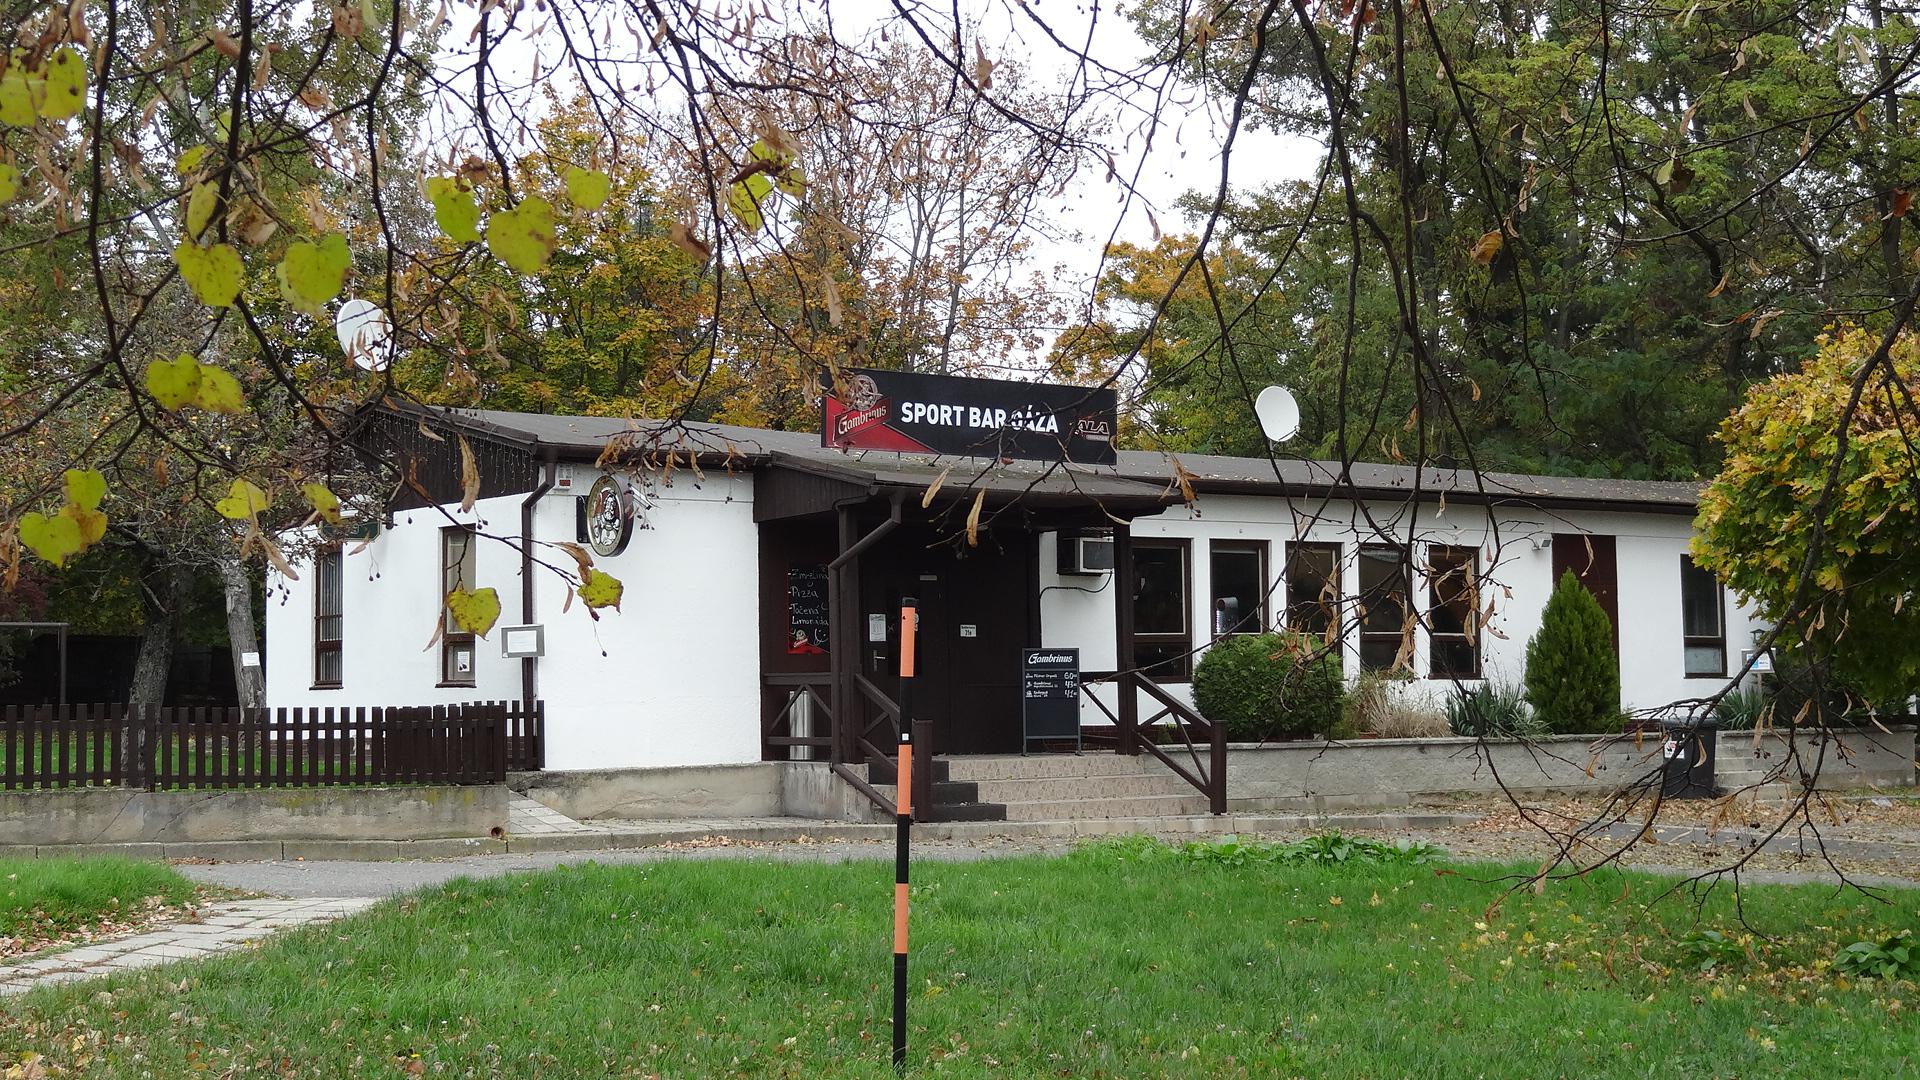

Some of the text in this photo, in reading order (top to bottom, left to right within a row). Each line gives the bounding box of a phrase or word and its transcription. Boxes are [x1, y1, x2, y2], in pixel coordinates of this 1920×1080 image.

[901, 402, 964, 427] SPORT
[969, 407, 1006, 429] BAR
[1028, 652, 1073, 664] Gambrinus
